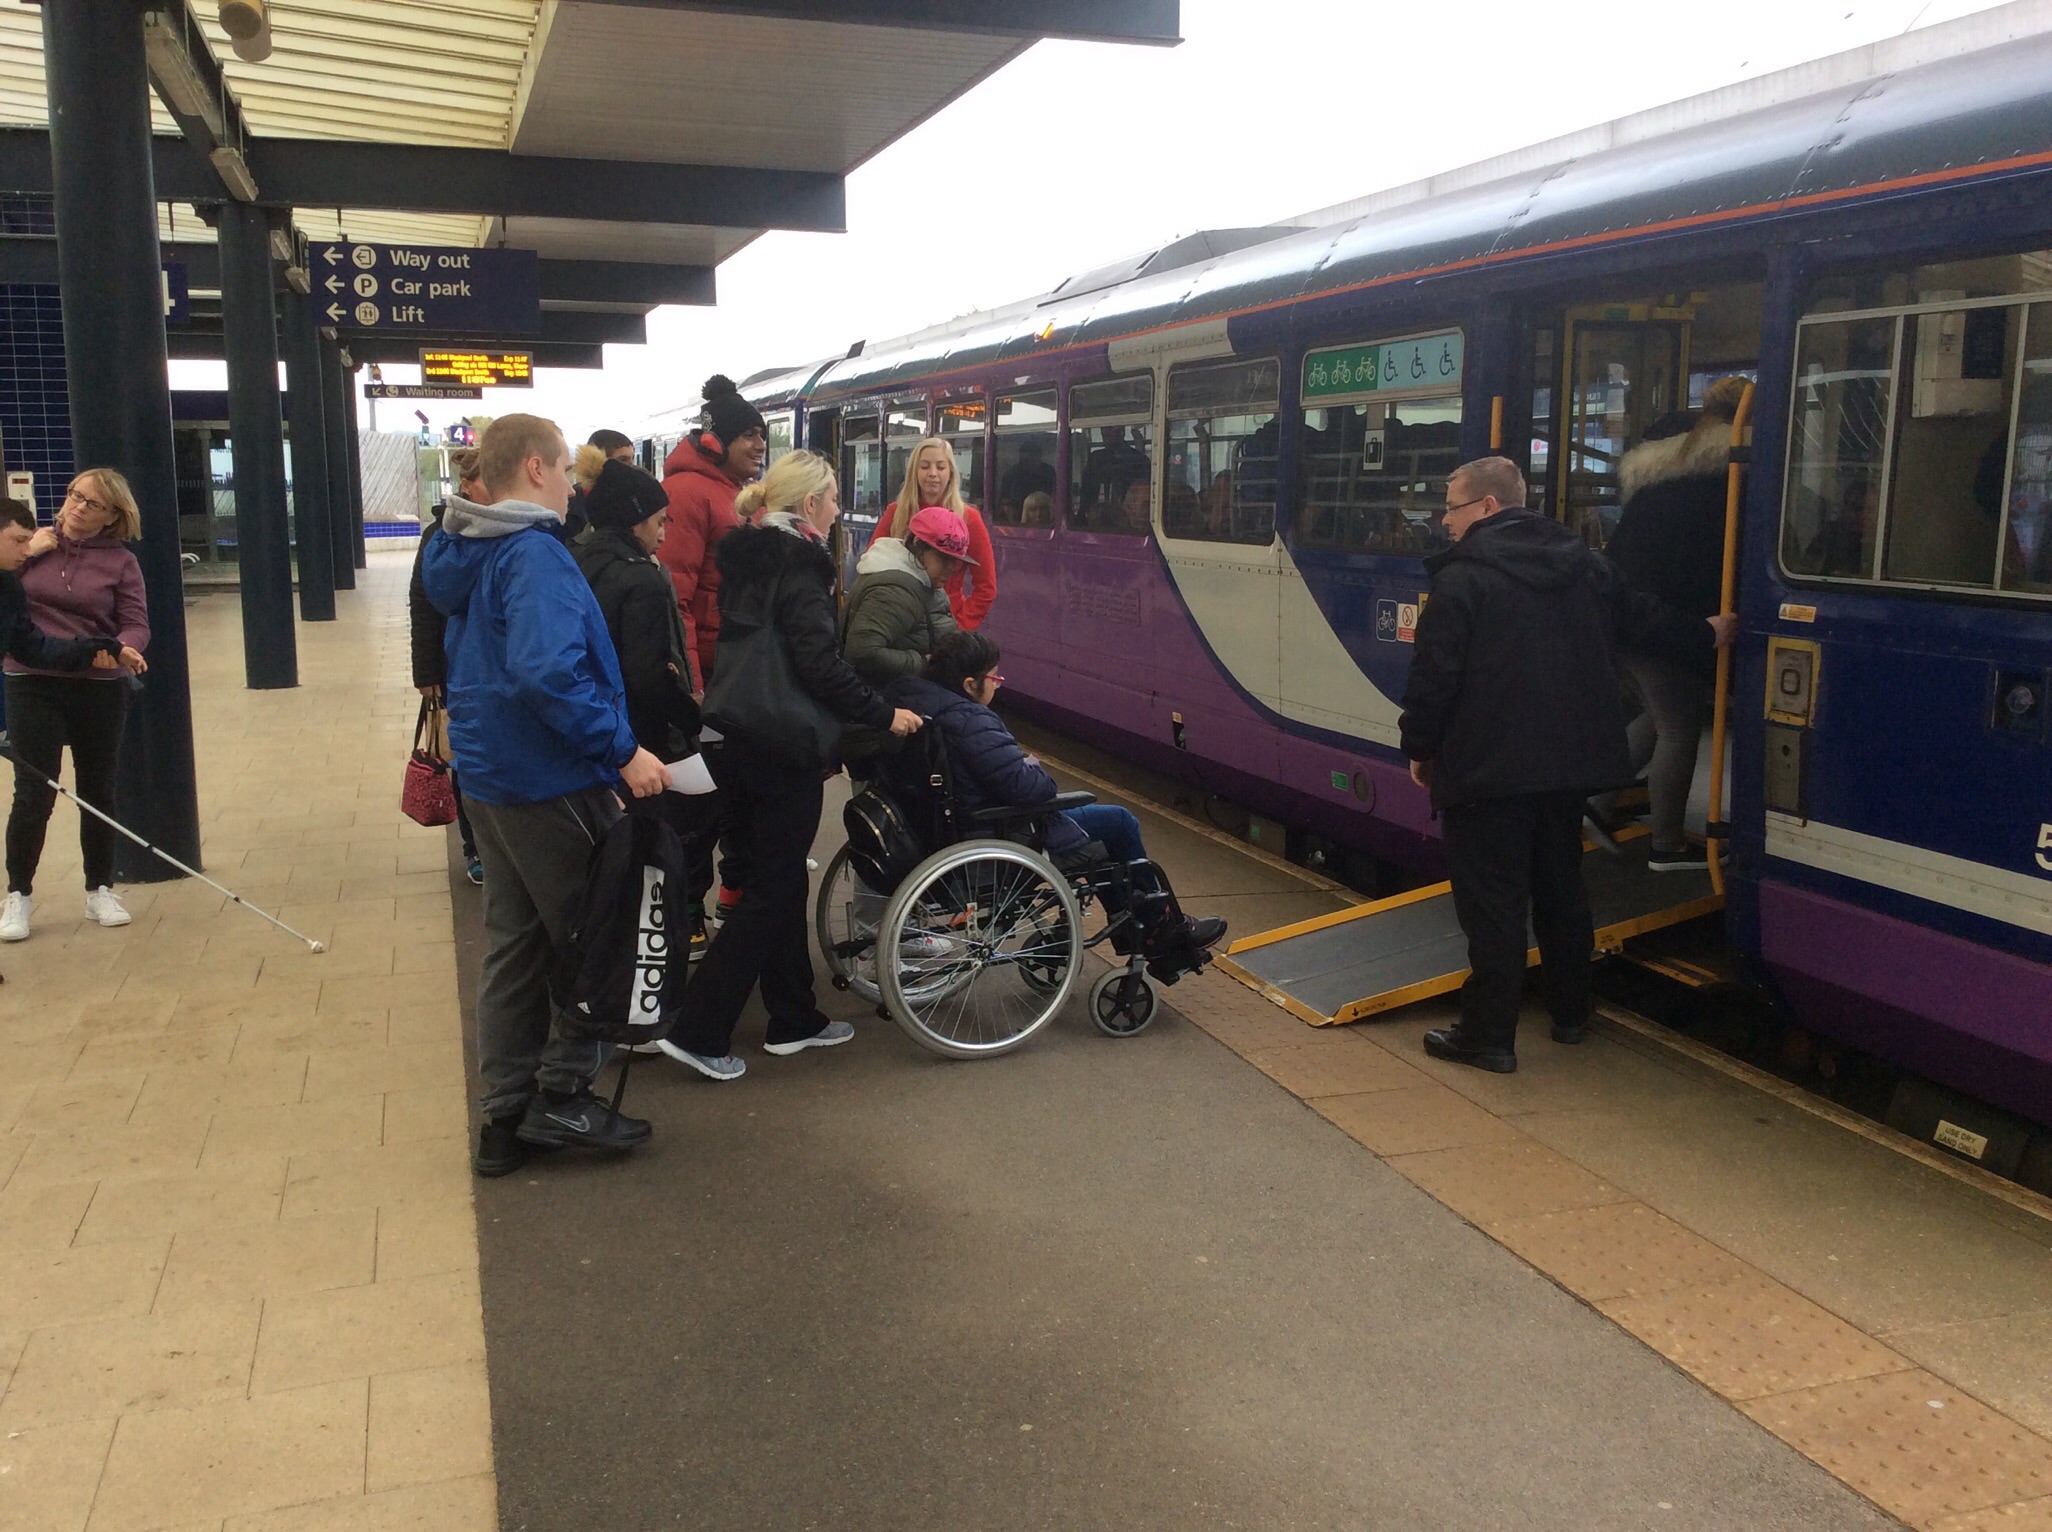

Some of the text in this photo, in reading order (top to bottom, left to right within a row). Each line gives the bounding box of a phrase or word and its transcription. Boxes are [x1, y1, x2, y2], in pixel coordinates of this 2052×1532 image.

[389, 249, 470, 271] Way out
[390, 278, 422, 295] Car
[429, 280, 471, 299] park
[392, 306, 425, 323] Lift
[405, 387, 473, 398] Waiting room
[453, 427, 465, 441] 4
[636, 880, 669, 1014] adidas
[1936, 1133, 1978, 1155] SAND ONLY
[1945, 1127, 1977, 1143] USE DRY
